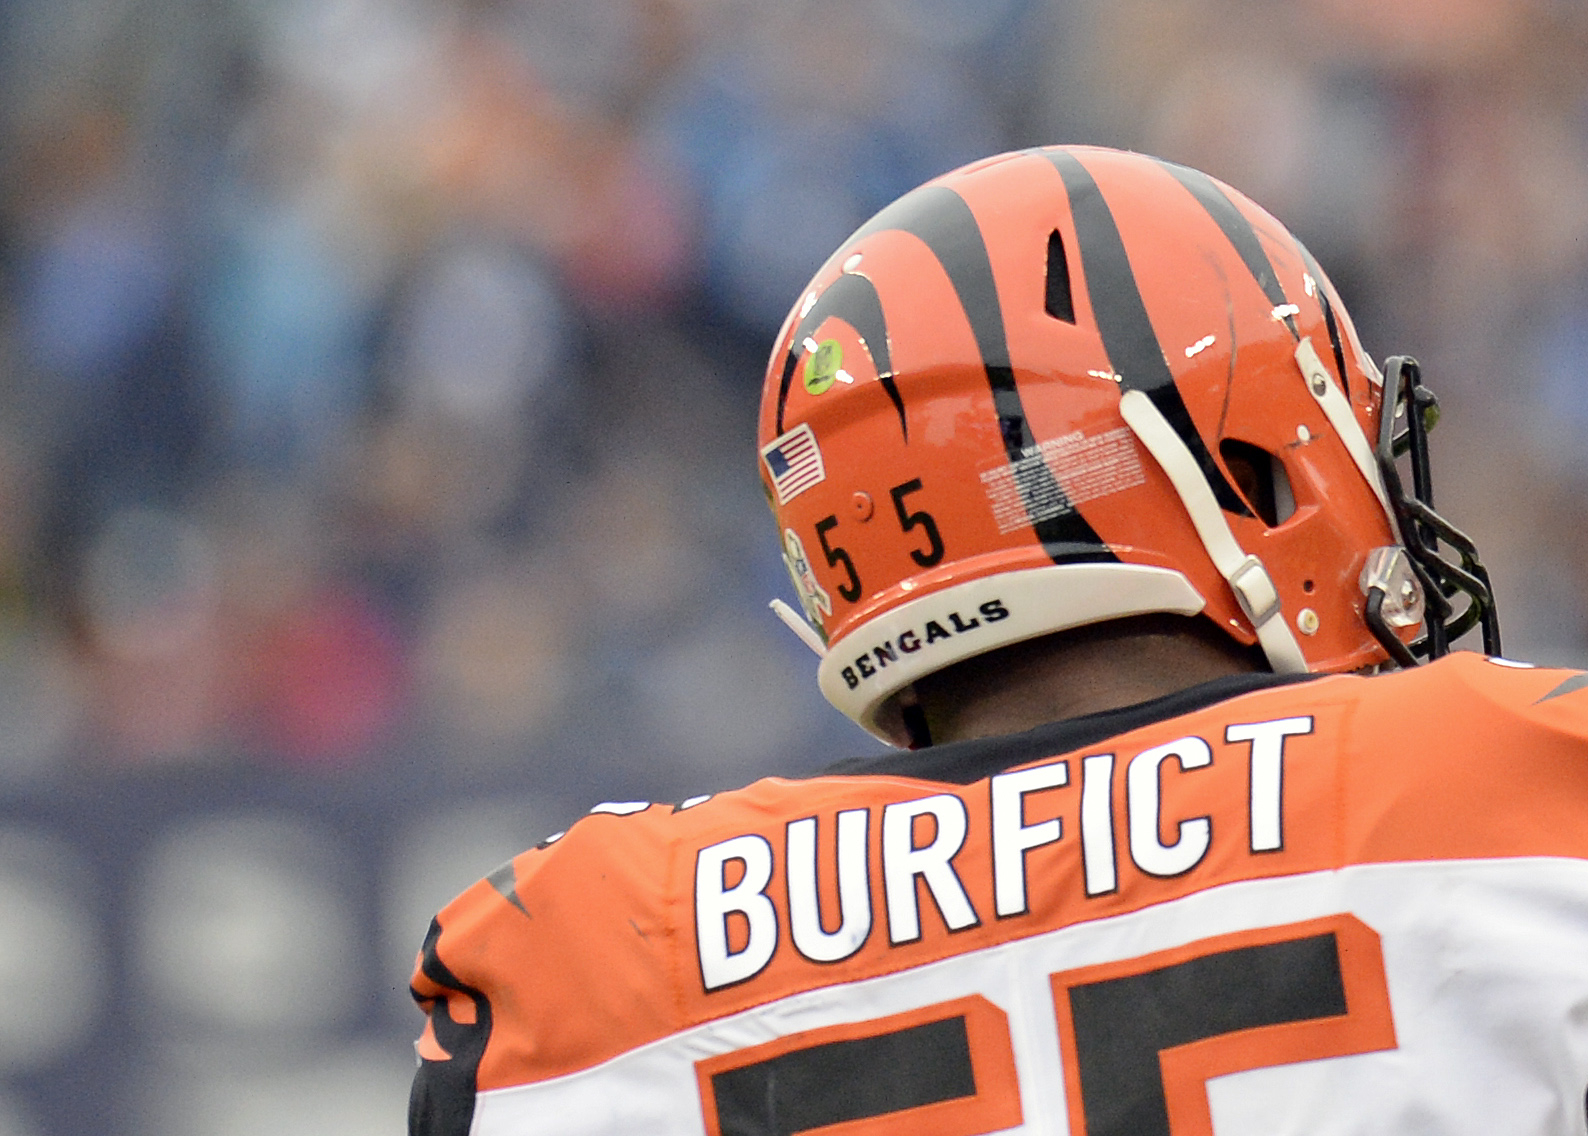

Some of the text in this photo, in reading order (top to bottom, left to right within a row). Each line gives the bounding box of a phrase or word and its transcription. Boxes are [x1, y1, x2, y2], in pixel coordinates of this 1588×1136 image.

[1021, 430, 1084, 458] WARNING
[841, 599, 1011, 690] BENGALS
[694, 716, 1314, 992] BURFICT
